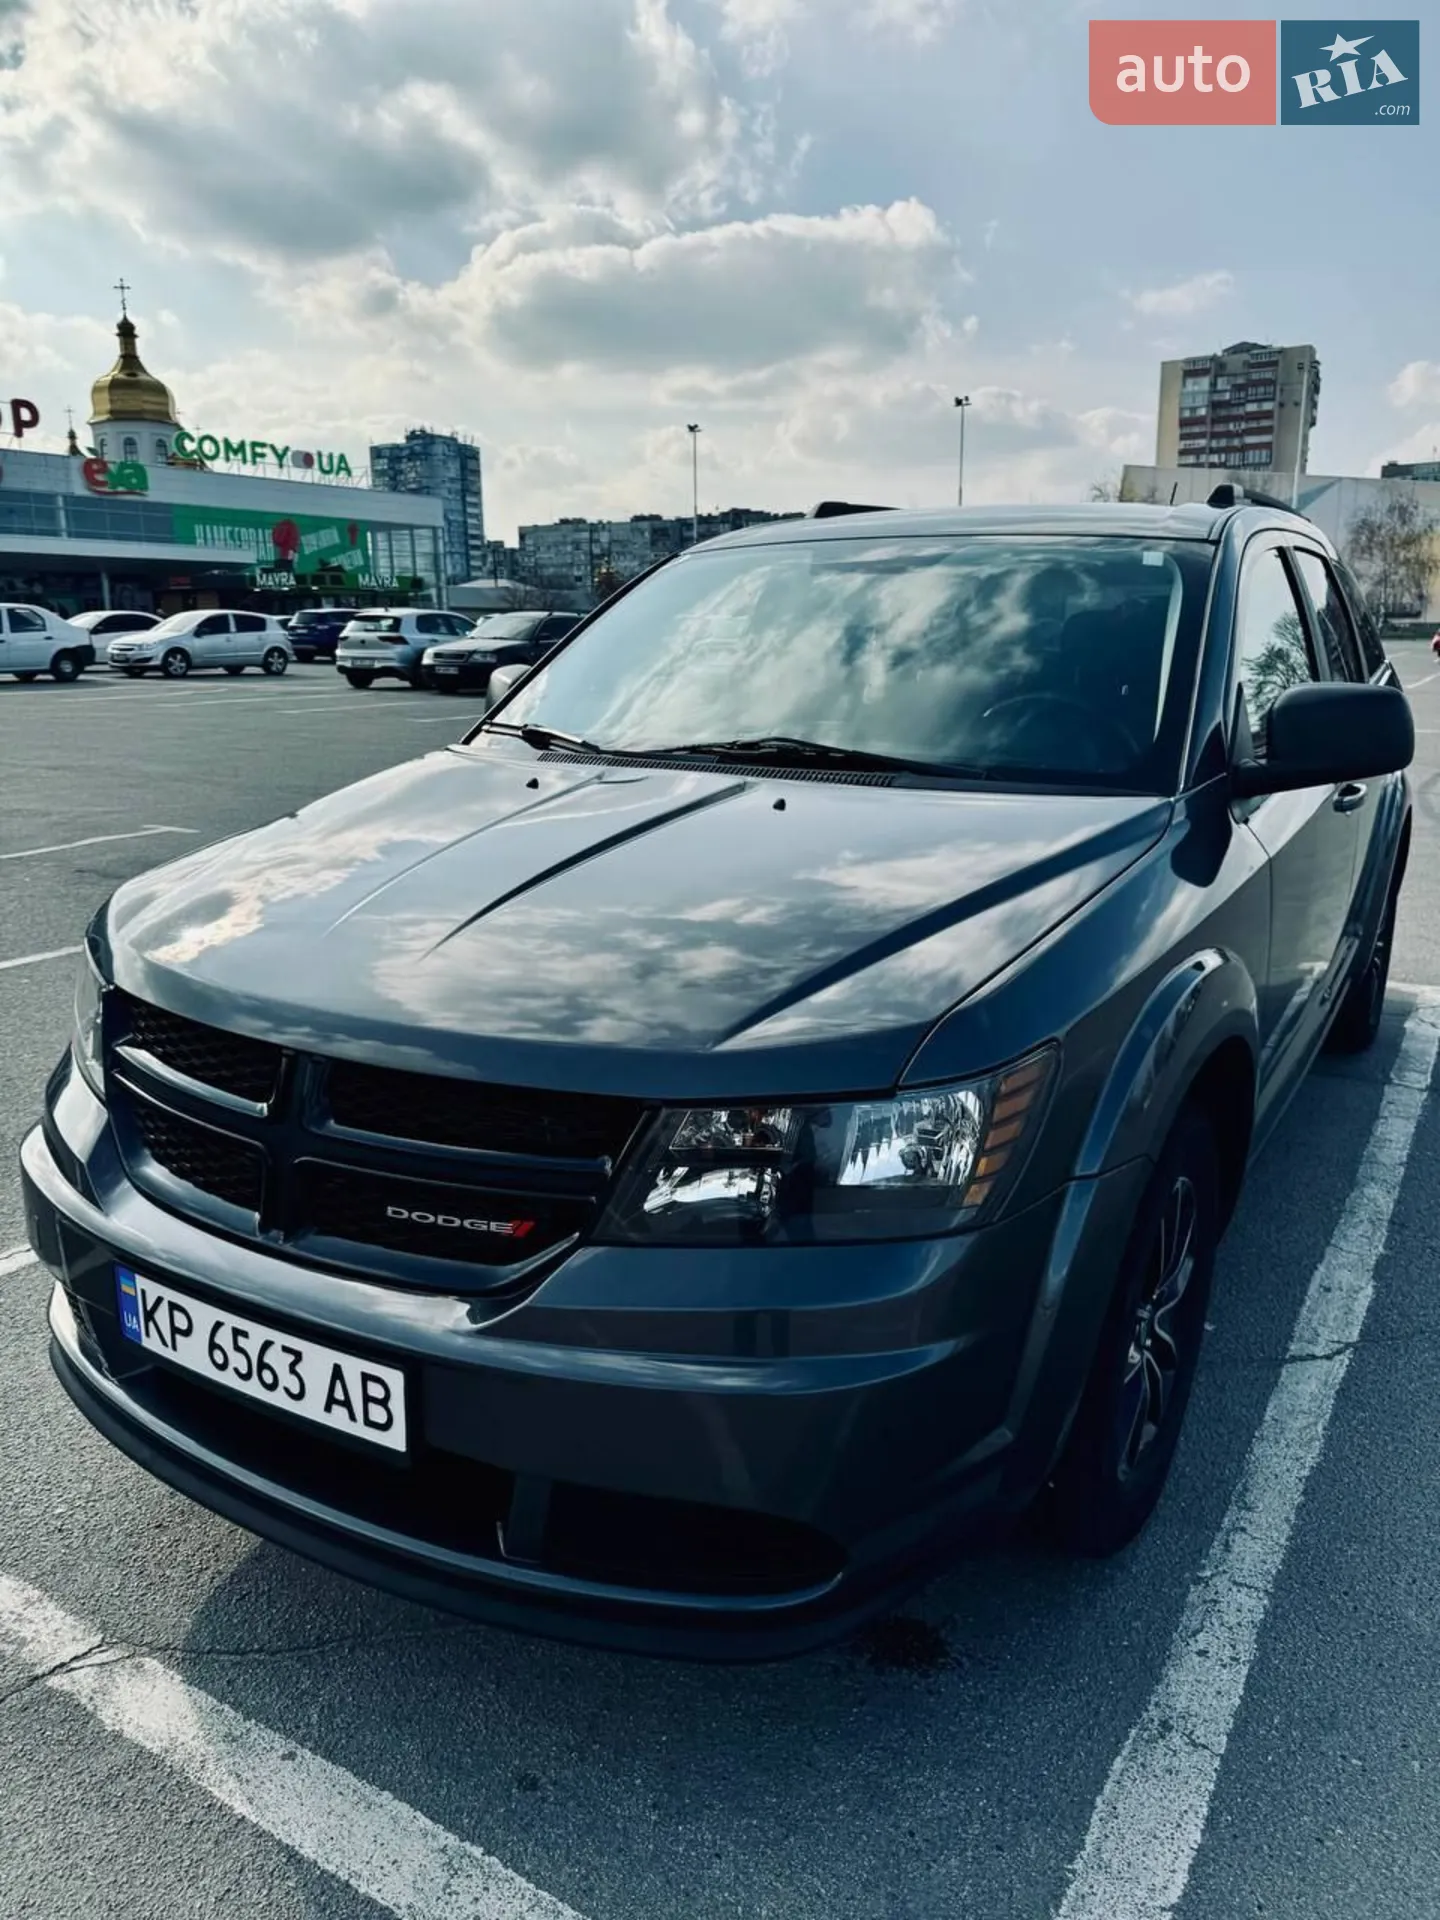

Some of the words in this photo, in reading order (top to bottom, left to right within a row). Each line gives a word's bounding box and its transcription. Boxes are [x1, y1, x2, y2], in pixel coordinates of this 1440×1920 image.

[173, 430, 291, 470] COMFY
[316, 451, 353, 477] UA
[386, 1205, 514, 1234] DODGE
[124, 1313, 140, 1332] UA
[140, 1287, 194, 1352] KP
[208, 1320, 306, 1402] 6563
[323, 1362, 394, 1433] AB
